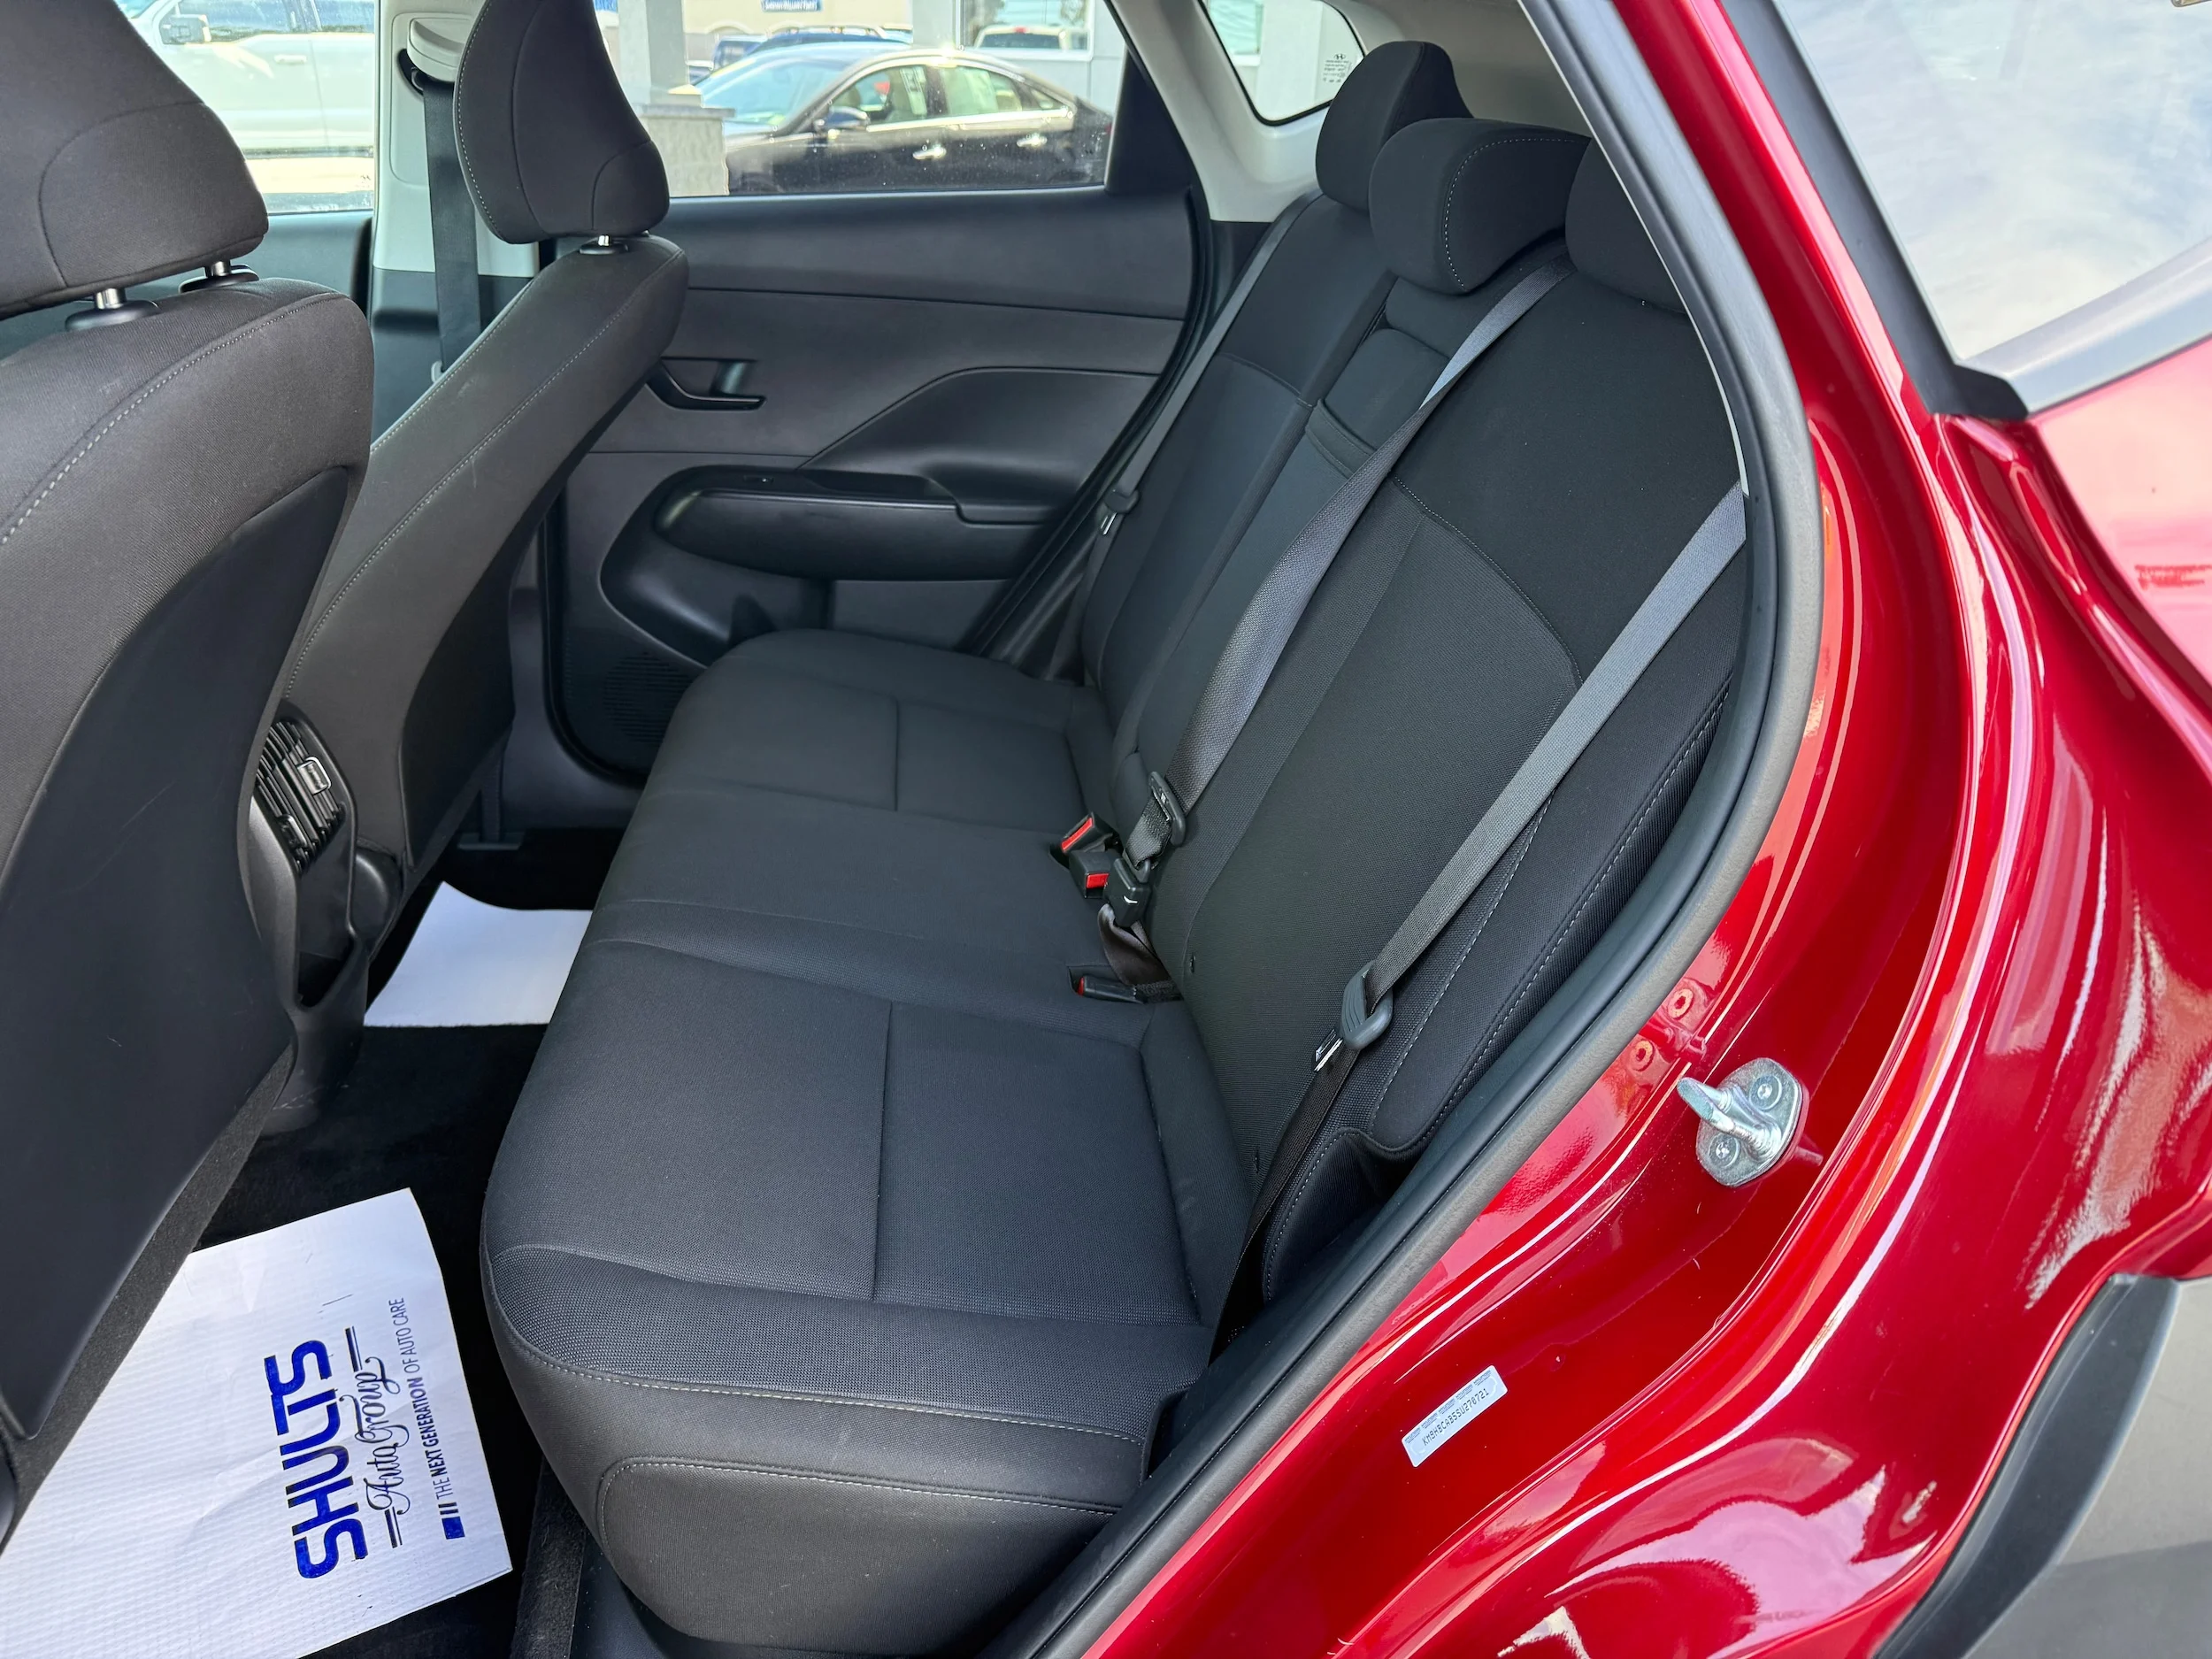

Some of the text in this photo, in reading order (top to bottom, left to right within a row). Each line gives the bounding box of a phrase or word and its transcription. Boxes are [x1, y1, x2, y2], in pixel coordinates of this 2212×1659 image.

[264, 1340, 368, 1578] SHULTS
[339, 1356, 411, 1516] Auto Group
[388, 1297, 454, 1500] THE NEXT GENERATION OF AUTO CARE
